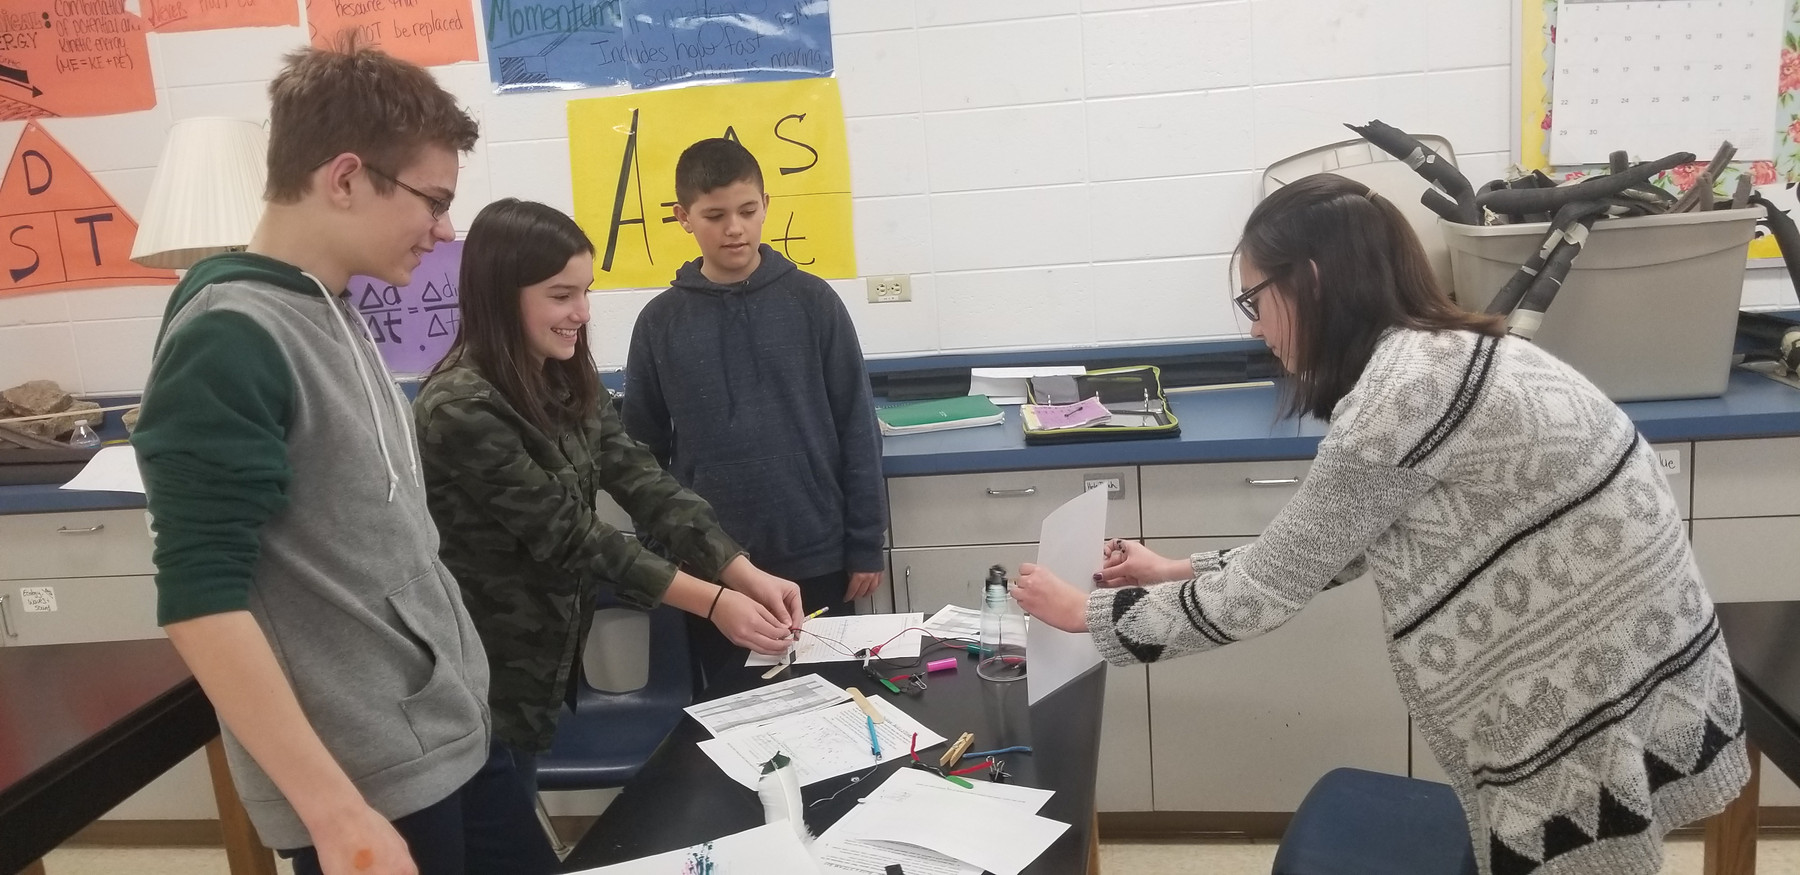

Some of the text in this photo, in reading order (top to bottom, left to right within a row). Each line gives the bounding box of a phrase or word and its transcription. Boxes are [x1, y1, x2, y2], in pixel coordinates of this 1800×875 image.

[72, 15, 119, 37] potential
[394, 19, 411, 38] be
[413, 10, 464, 43] replaced
[488, 0, 622, 43] Momentum
[590, 21, 765, 66] Includes how fast
[746, 59, 761, 74] is
[22, 150, 53, 196] D
[601, 108, 653, 272] A
[9, 224, 40, 283] S
[74, 213, 113, 266] T
[771, 212, 816, 266] t
